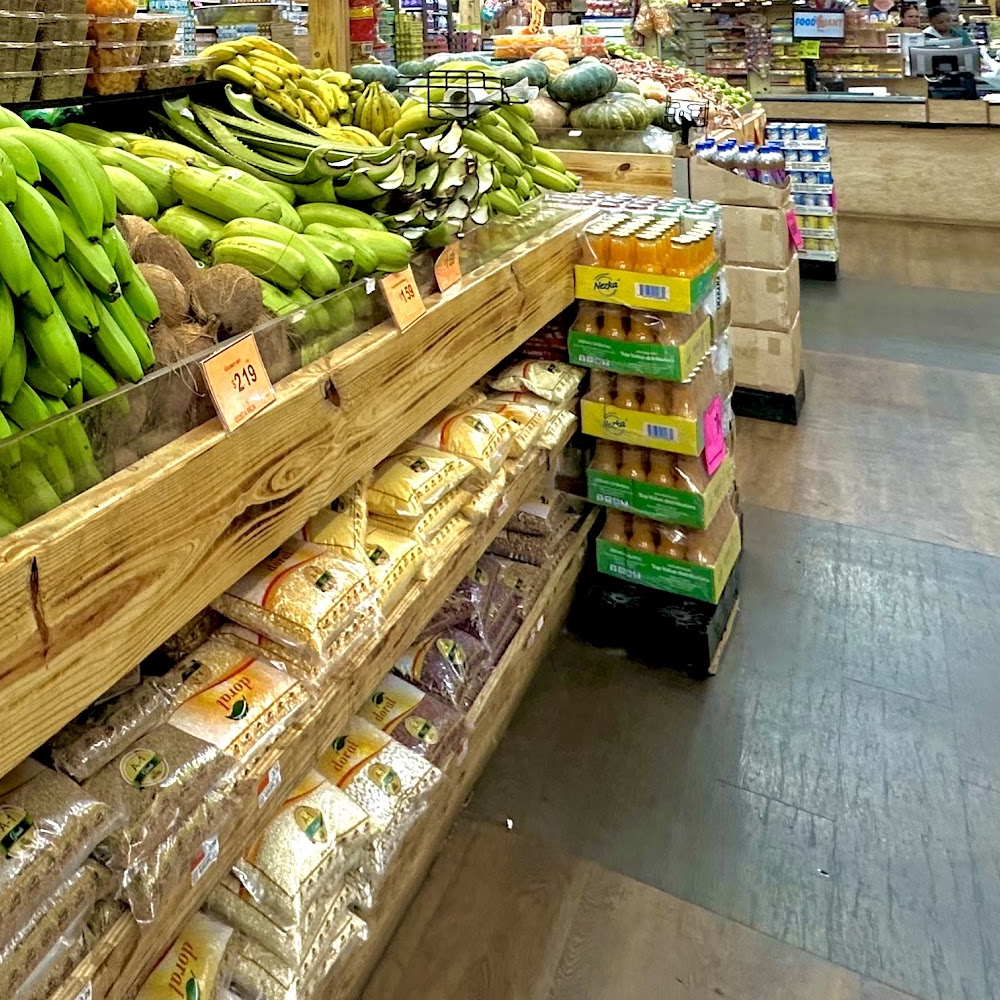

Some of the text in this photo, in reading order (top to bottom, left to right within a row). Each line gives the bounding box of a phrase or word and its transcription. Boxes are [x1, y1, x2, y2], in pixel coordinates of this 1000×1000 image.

[795, 17, 816, 27] FOOD
[593, 280, 619, 291] Nezka
[215, 675, 254, 712] doral
[373, 696, 397, 722] doral
[130, 754, 147, 772] A-1
[332, 739, 360, 772] doral
[168, 941, 198, 999] doral
